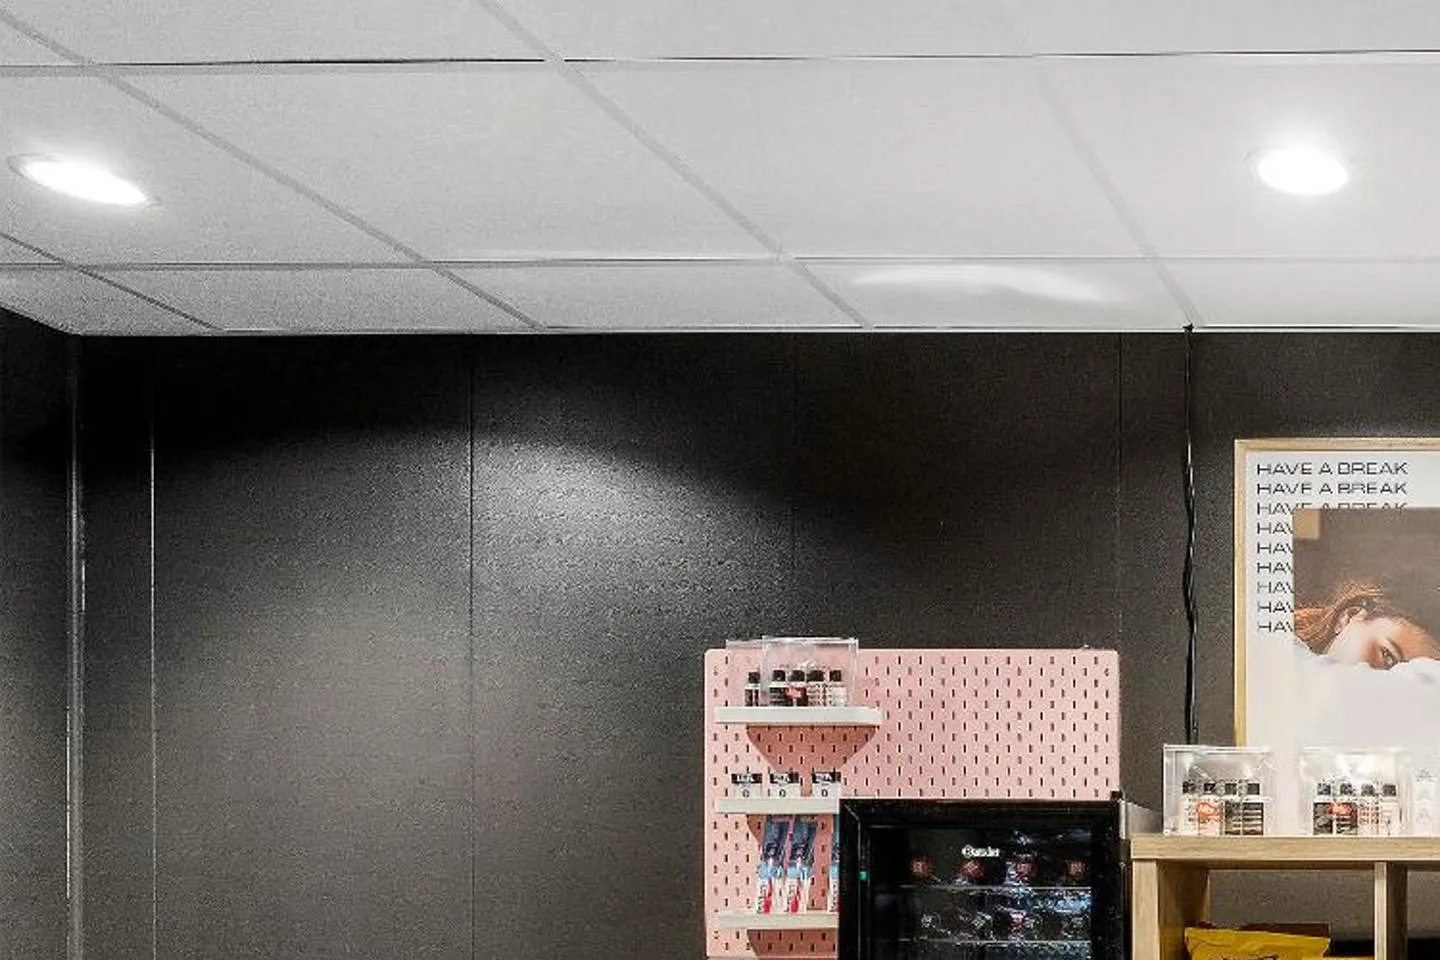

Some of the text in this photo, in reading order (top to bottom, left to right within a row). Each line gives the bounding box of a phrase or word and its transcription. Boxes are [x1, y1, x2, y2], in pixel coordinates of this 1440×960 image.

[1256, 462, 1408, 475] HAVE A BREAK
[1256, 482, 1408, 495] HAVE A BREAK
